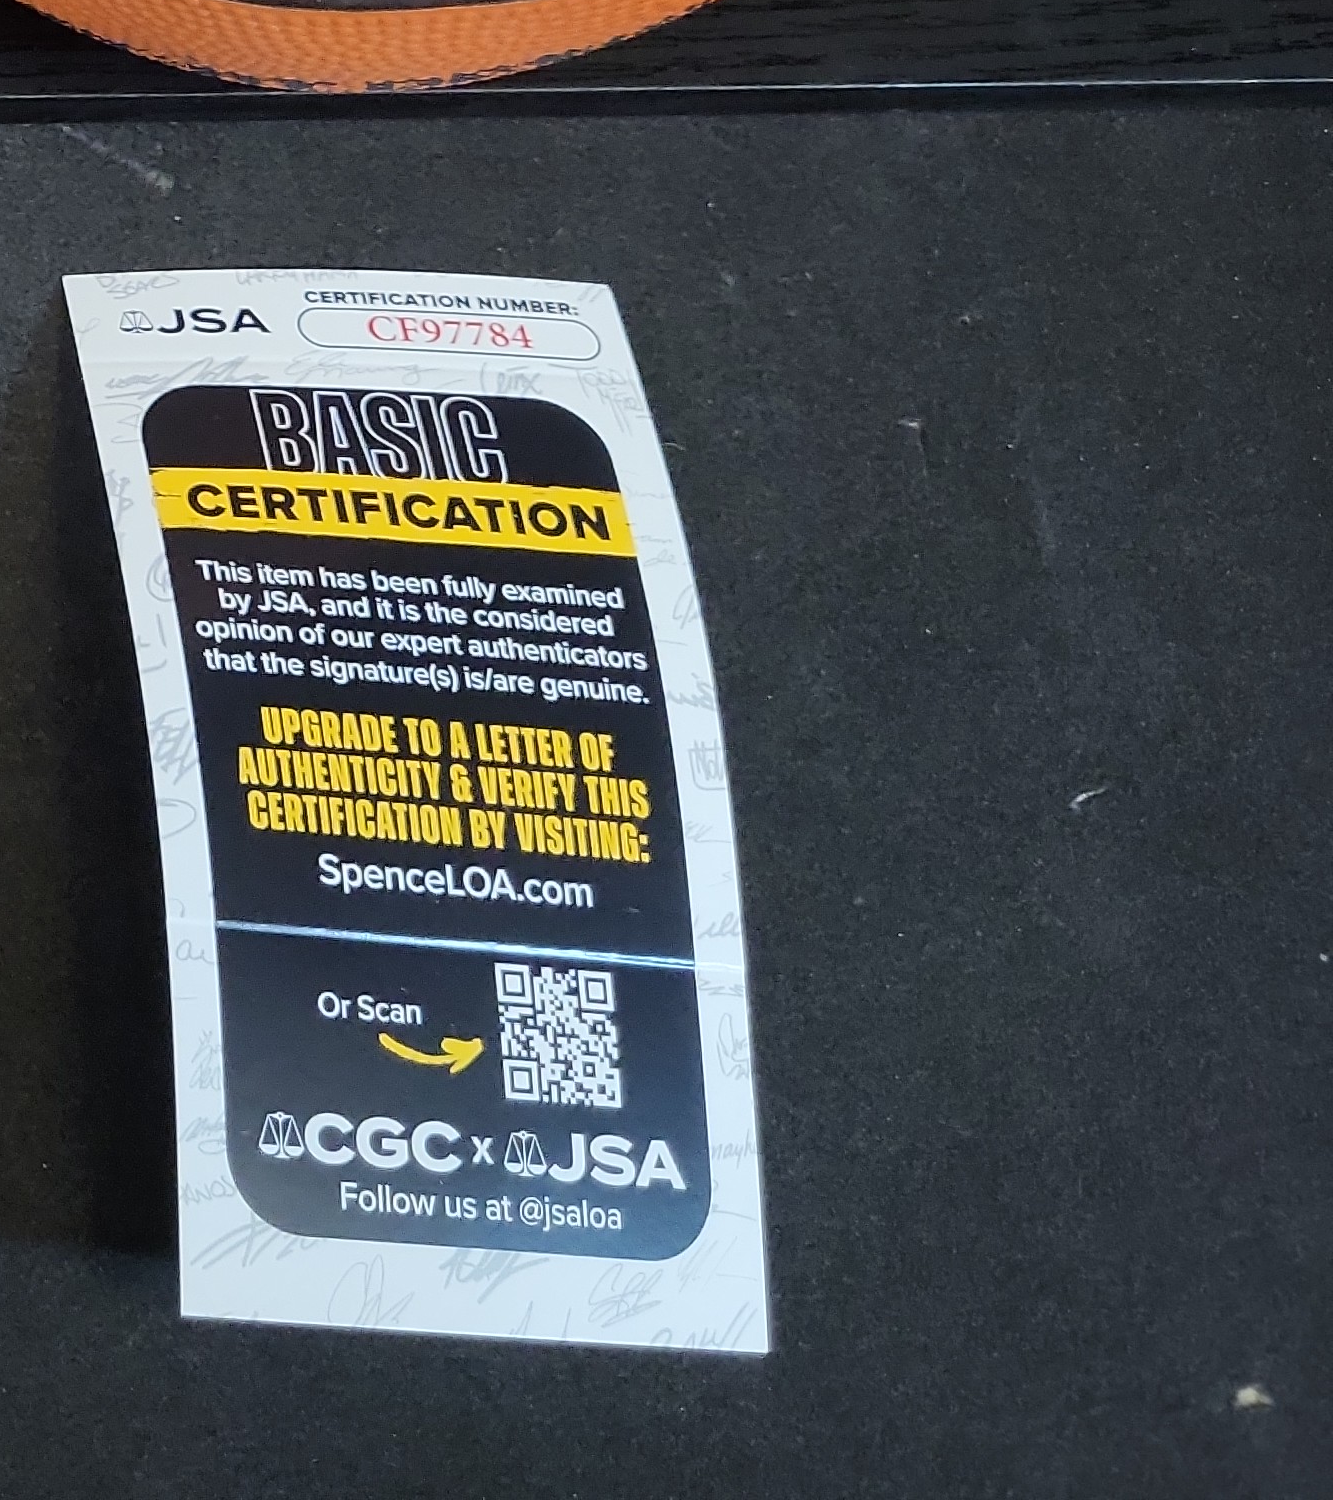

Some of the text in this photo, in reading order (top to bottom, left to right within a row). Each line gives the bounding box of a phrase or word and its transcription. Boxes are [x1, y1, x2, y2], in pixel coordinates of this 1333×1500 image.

[157, 308, 271, 334] JSA
[304, 291, 580, 317] CERTIFICATION NUMBER:
[368, 316, 533, 350] CF97784
[249, 389, 508, 484] BASIC
[188, 484, 612, 540] CERTIFICATION
[194, 559, 625, 610] This item has been fully examined
[217, 587, 616, 637] by JSA, and the considered
[195, 616, 649, 671] opinion of our expert authenticators
[202, 647, 651, 705] that the signature(s) is/are genuine.
[260, 706, 615, 773] UPGRADE TO LETTER OF
[238, 746, 651, 820] AUTHENTICITY VERIFY THIS
[247, 789, 649, 864] CERTIFICATION BY VISITING:
[318, 853, 595, 909] SpenceLOA.com
[317, 991, 424, 1026] Or Scan
[304, 1112, 463, 1173] CGC
[549, 1133, 687, 1191] JSA
[339, 1180, 623, 1234] Follow us at @jsaloa
